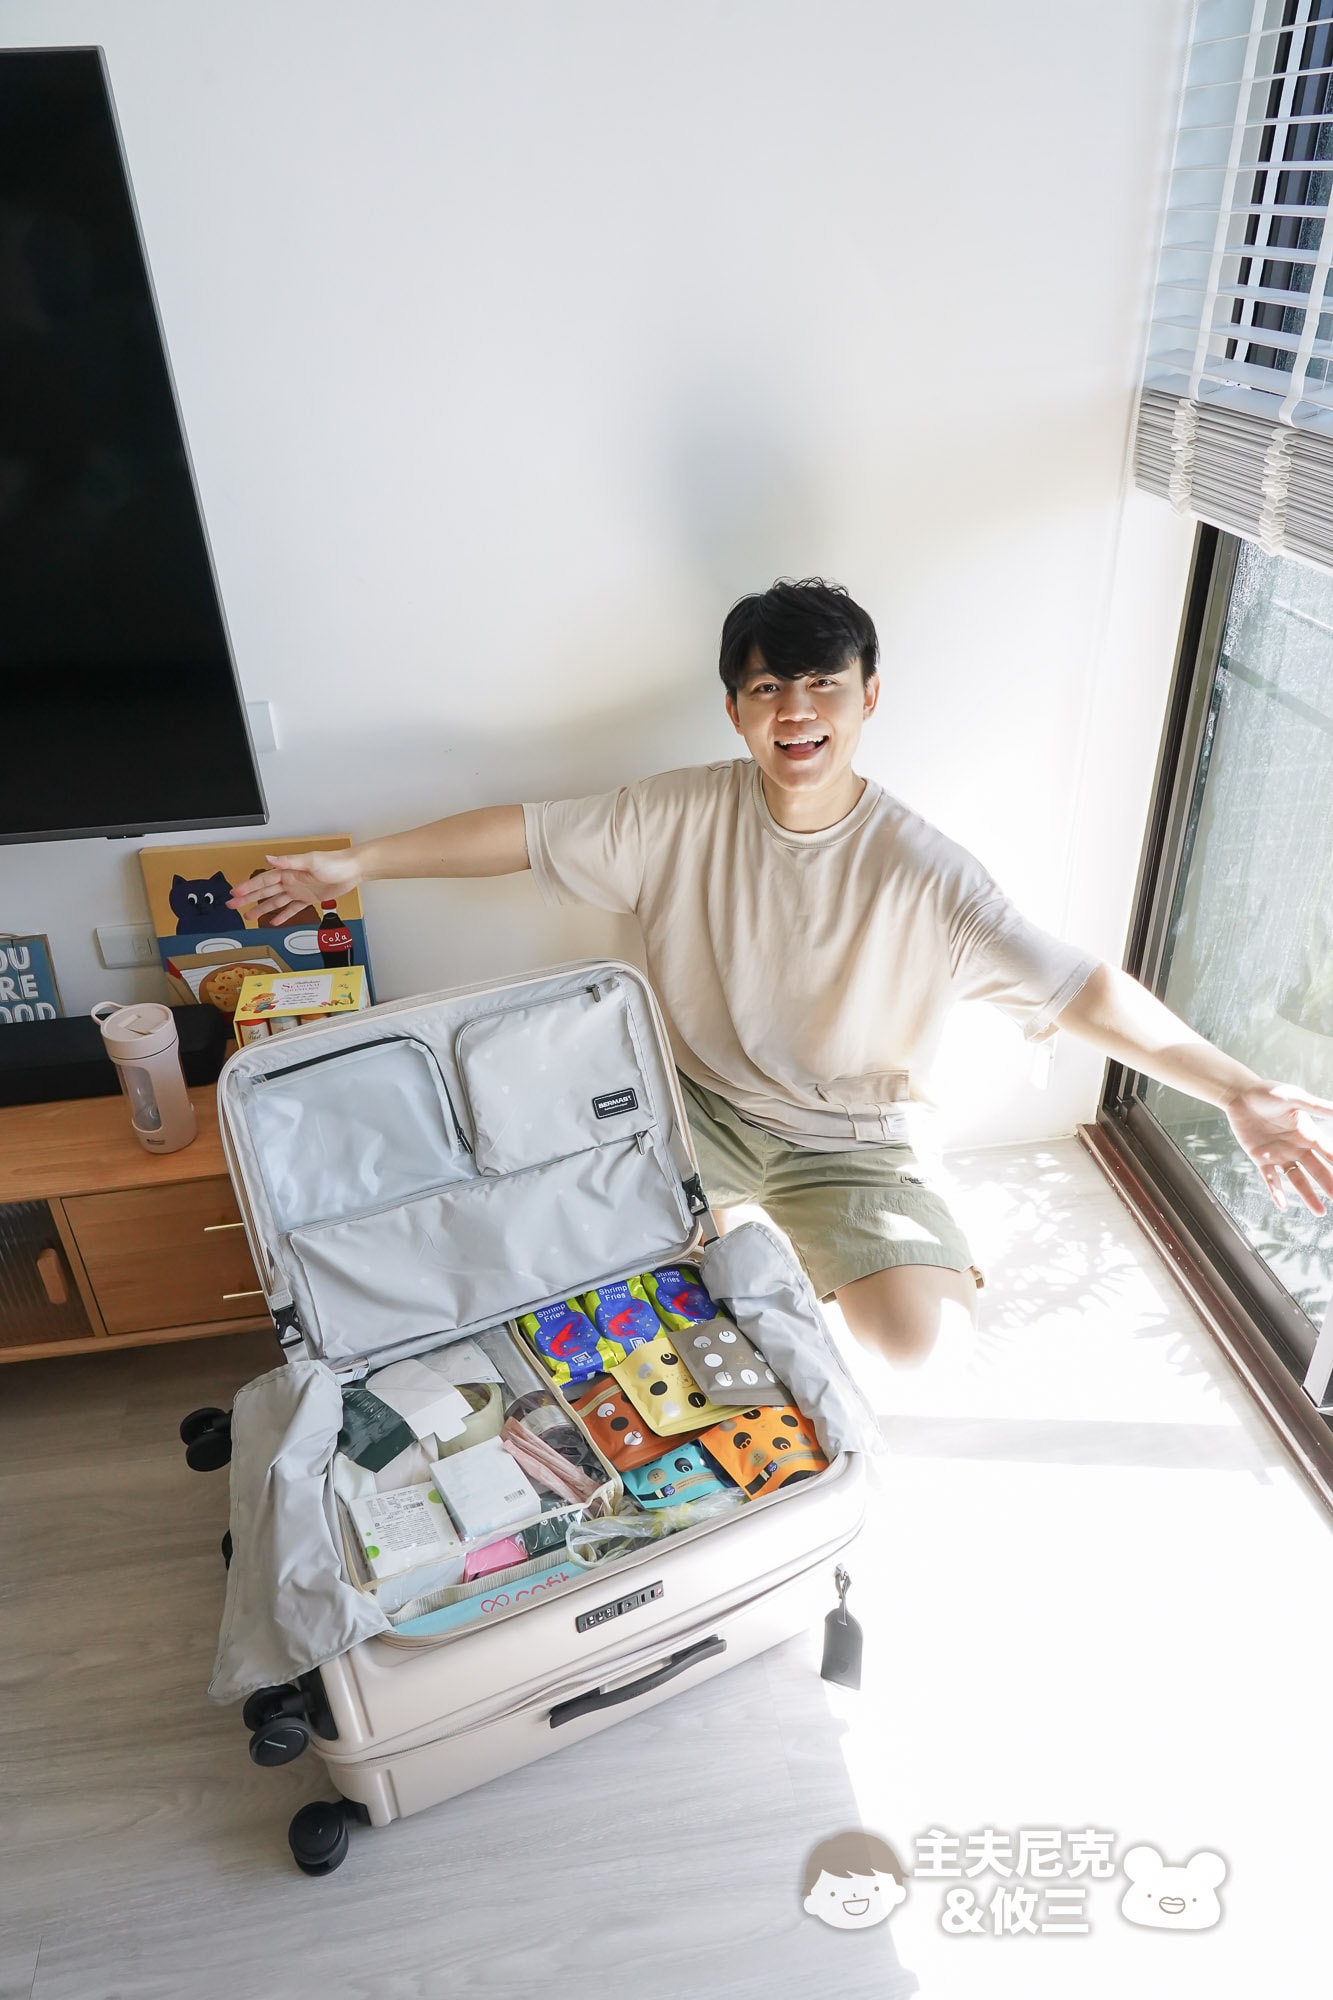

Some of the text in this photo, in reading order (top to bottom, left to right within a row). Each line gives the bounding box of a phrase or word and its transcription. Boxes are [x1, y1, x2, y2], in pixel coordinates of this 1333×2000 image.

[321, 932, 348, 944] Cola
[655, 1270, 680, 1278] Shrimp
[661, 1276, 681, 1284] Fries
[598, 1285, 628, 1297] Shrimp
[605, 1292, 627, 1301] Fries
[536, 1303, 566, 1318] Shrimp
[544, 1310, 566, 1323] Fries
